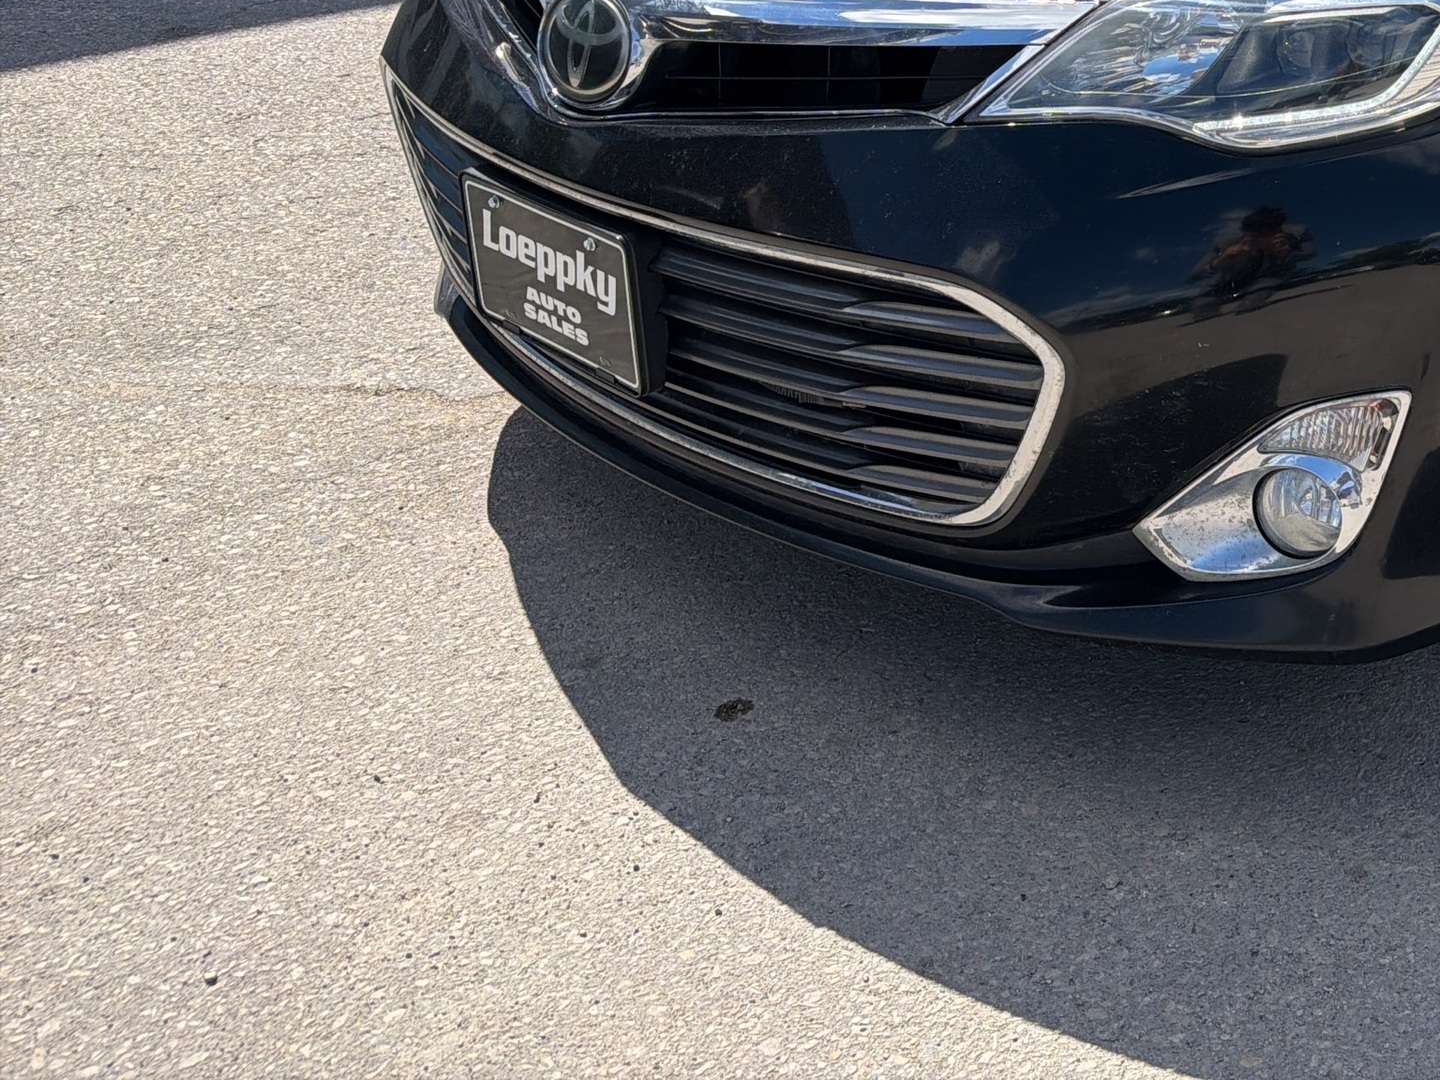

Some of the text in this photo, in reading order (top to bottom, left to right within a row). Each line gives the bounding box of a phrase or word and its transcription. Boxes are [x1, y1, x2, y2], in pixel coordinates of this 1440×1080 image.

[482, 208, 617, 316] Loeppky
[523, 302, 590, 347] SALES
[526, 286, 582, 325] AUTO
